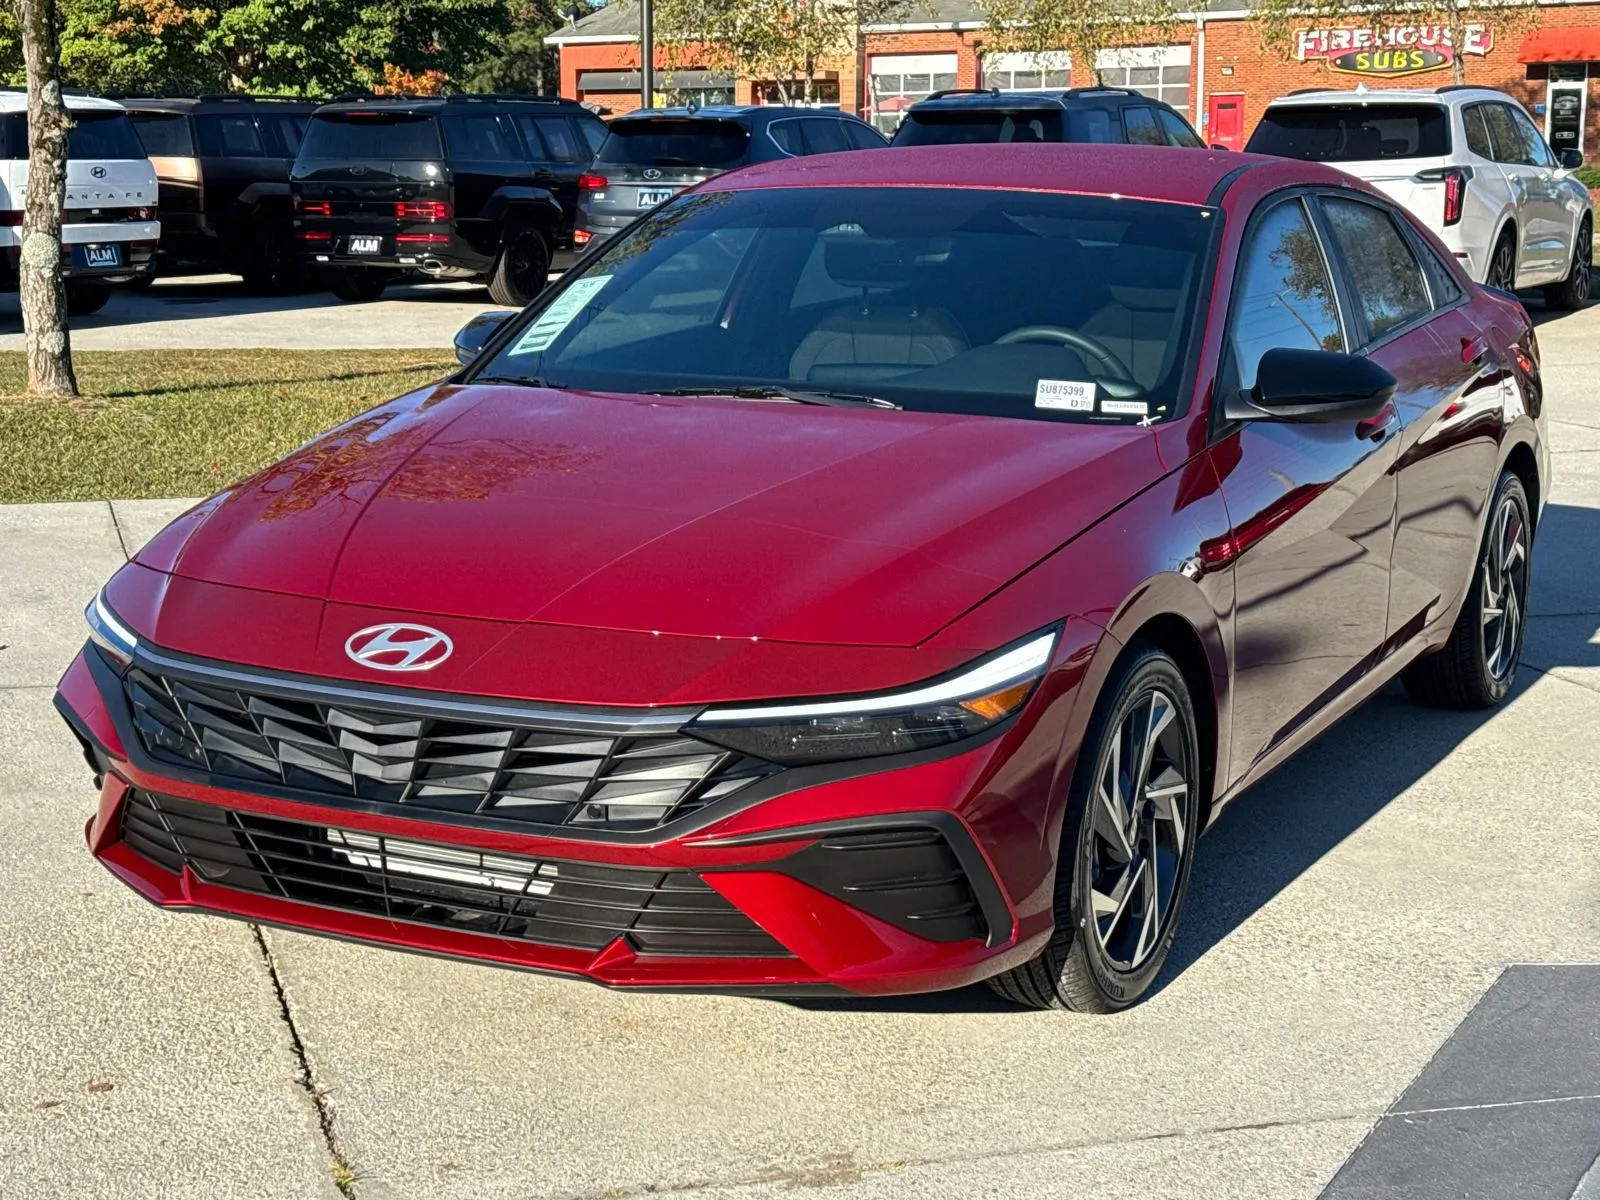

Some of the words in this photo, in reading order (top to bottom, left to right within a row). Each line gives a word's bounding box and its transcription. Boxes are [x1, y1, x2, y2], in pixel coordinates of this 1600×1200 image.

[1355, 50, 1425, 69] SUBS
[351, 239, 378, 252] ALM
[90, 249, 112, 261] ALM
[1040, 384, 1084, 396] SU875399
[1097, 966, 1126, 998] KUMHO
